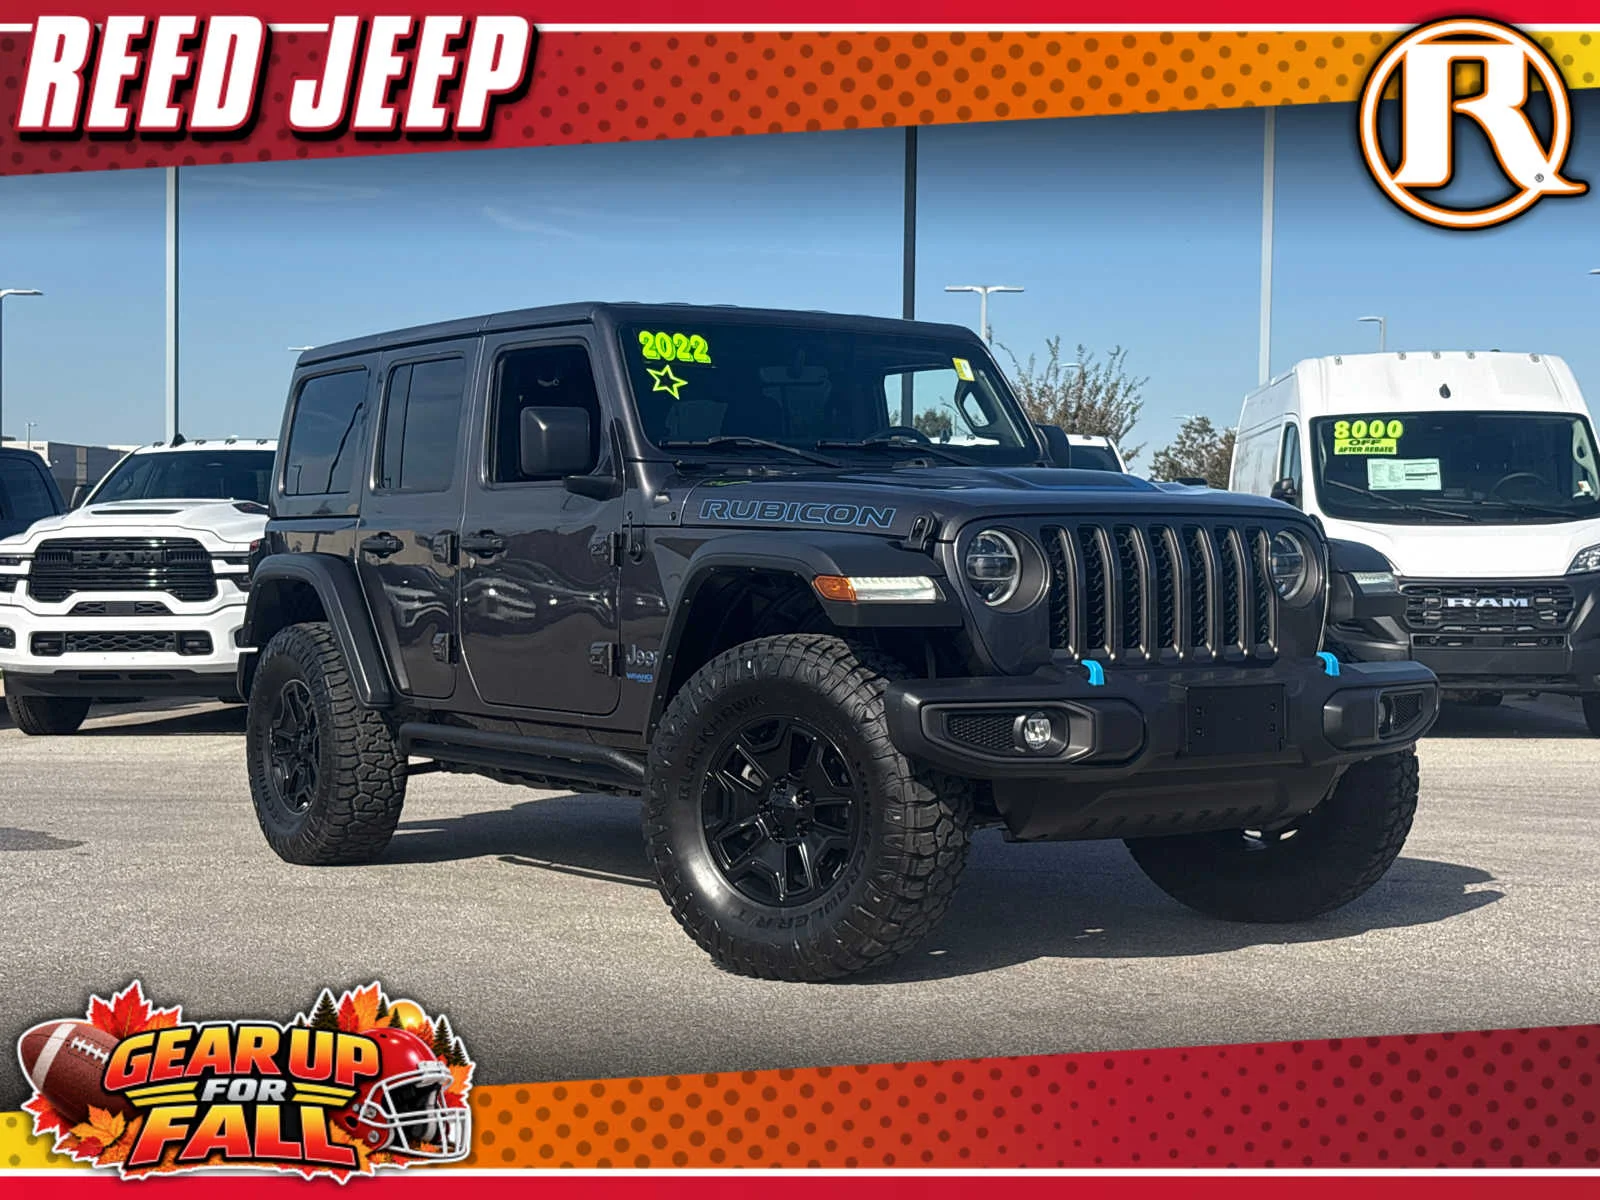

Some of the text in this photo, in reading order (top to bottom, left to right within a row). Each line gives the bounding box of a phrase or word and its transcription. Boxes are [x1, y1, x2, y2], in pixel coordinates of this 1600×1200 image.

[638, 330, 712, 364] 2022
[1334, 419, 1403, 439] 8000
[699, 499, 896, 529] RUBICON
[71, 549, 163, 565] RAM
[1446, 597, 1528, 608] RAM
